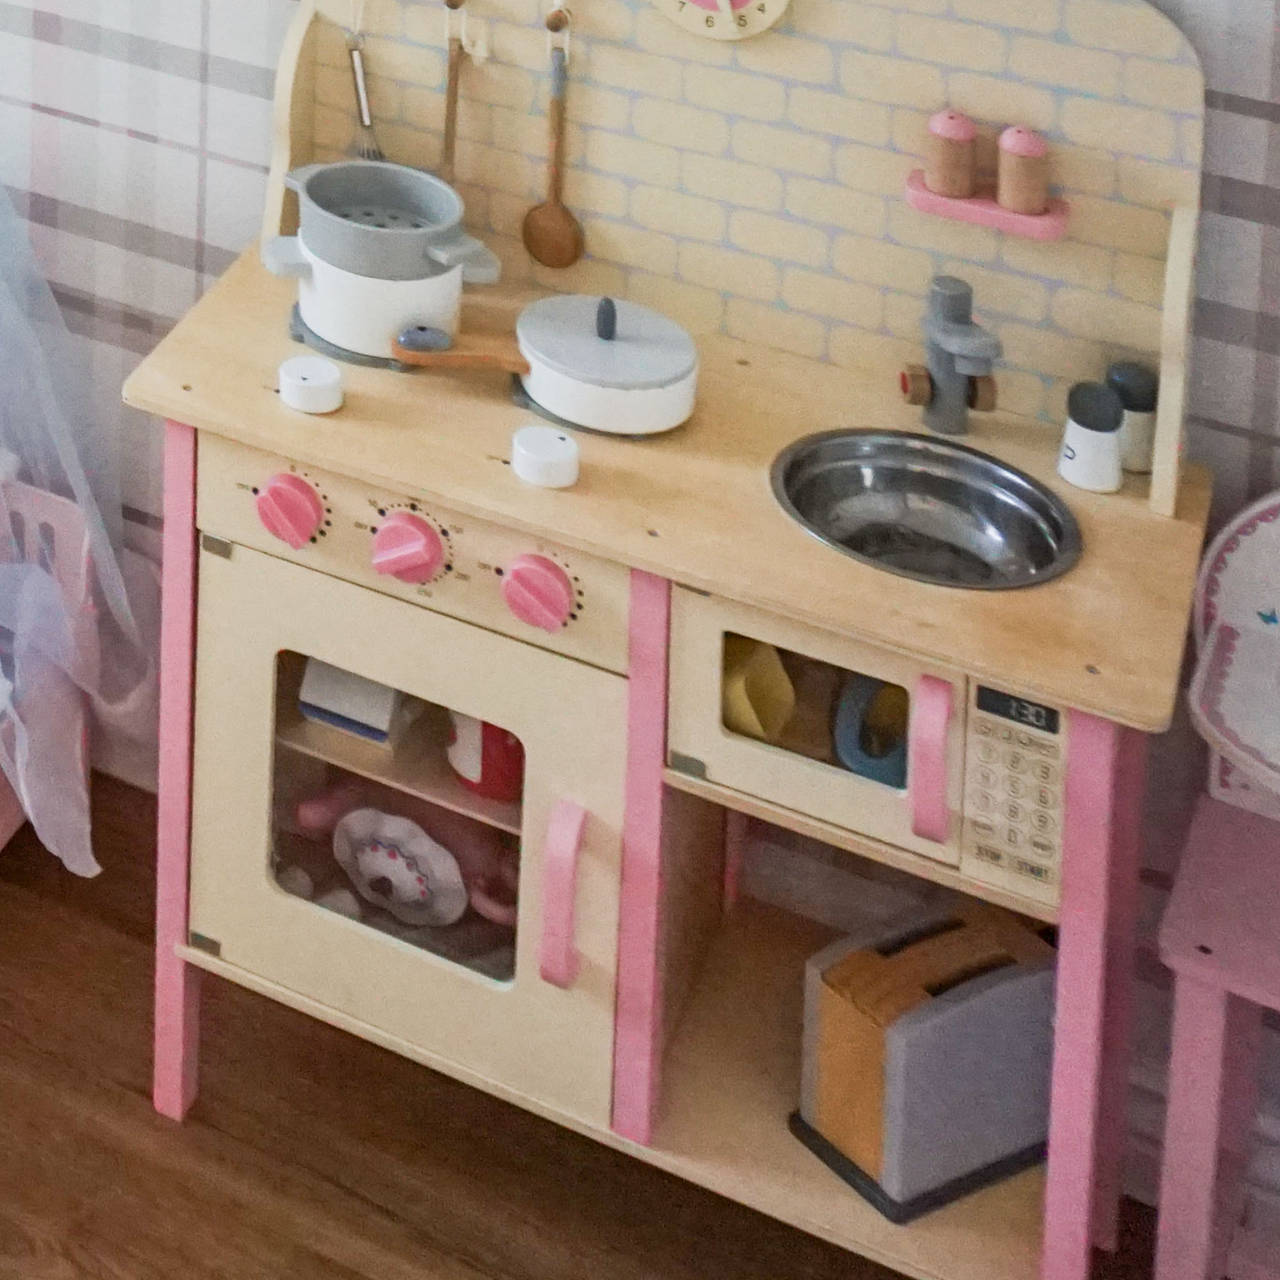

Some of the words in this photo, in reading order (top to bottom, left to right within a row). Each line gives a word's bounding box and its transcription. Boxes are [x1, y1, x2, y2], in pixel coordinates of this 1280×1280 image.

[678, 0, 687, 12] 7
[756, 3, 766, 15] 4
[705, 15, 715, 28] 6
[737, 14, 748, 28] 5
